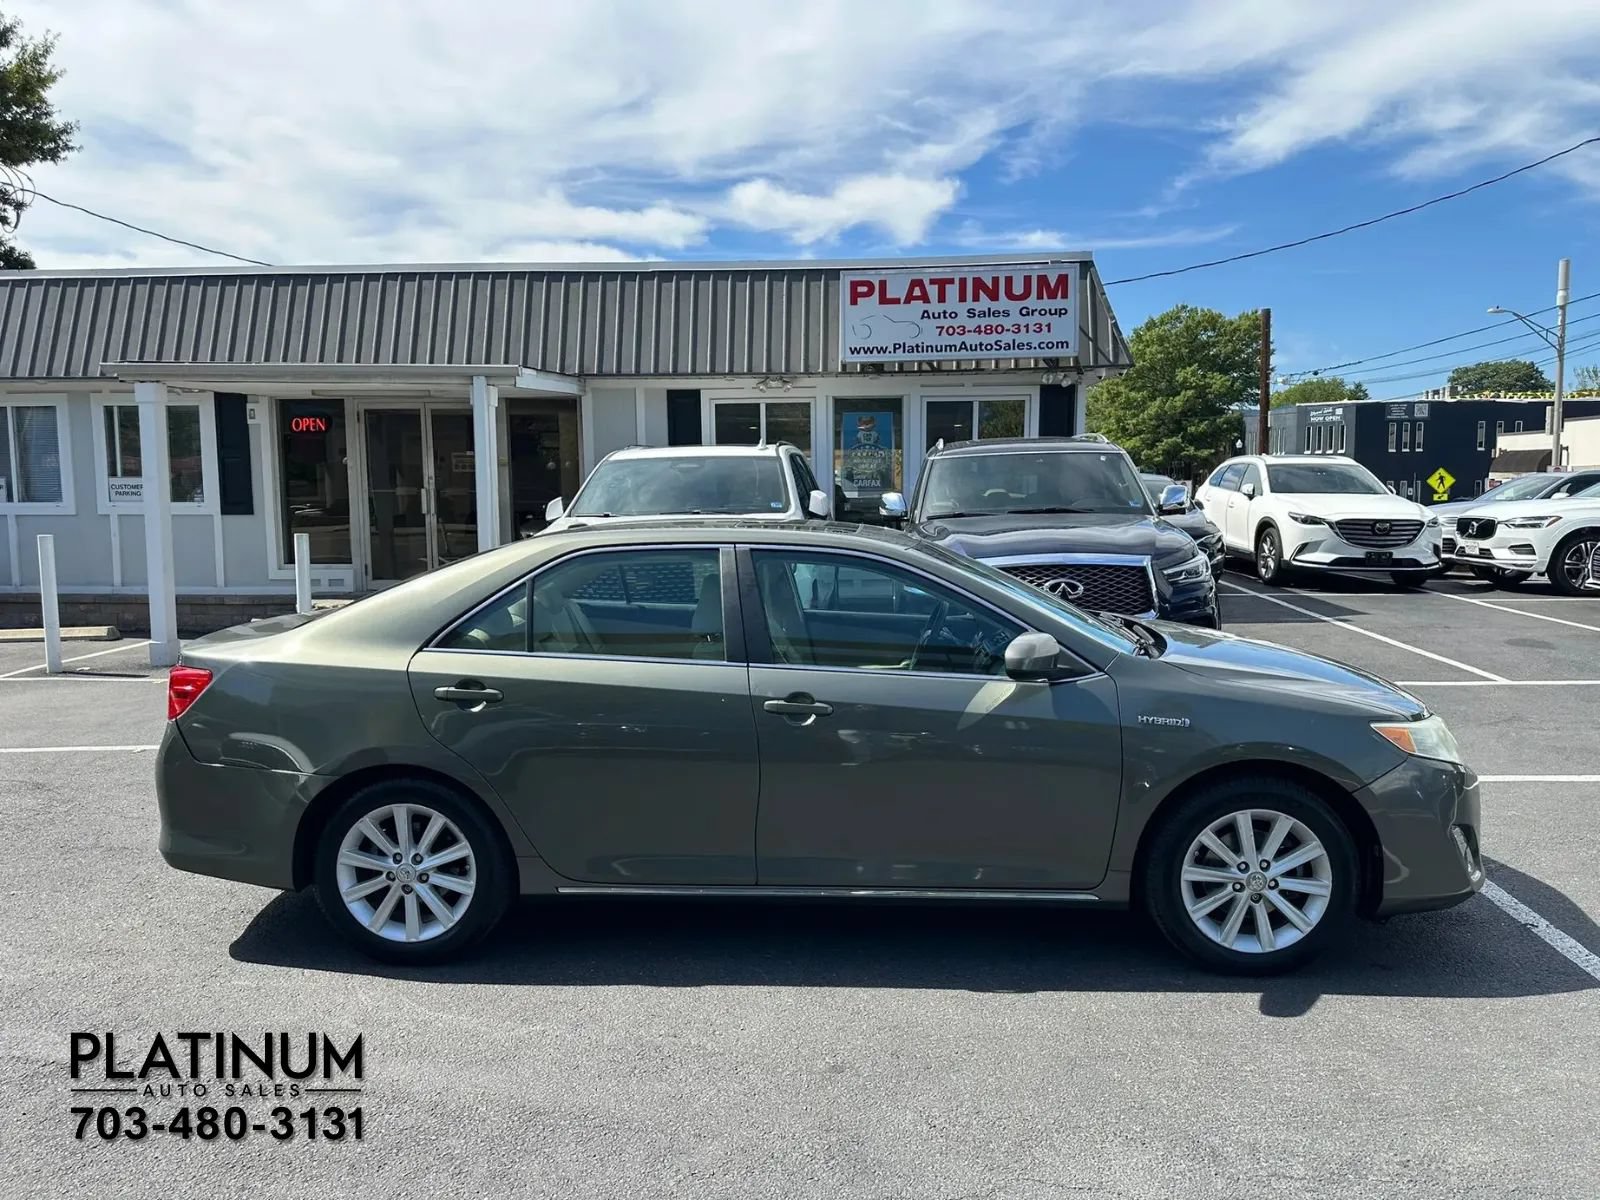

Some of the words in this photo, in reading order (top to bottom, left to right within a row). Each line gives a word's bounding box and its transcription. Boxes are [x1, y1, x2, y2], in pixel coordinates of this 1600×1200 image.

[849, 274, 1069, 305] PLATINUM
[920, 309, 958, 321] Auto
[966, 307, 1011, 319] Sales
[1019, 306, 1068, 318] Group
[935, 322, 1052, 337] 703-480-3131
[849, 340, 1069, 355] www.PlatinumAutoSales.com
[291, 417, 326, 432] OPEN
[853, 479, 881, 487] CARFAX
